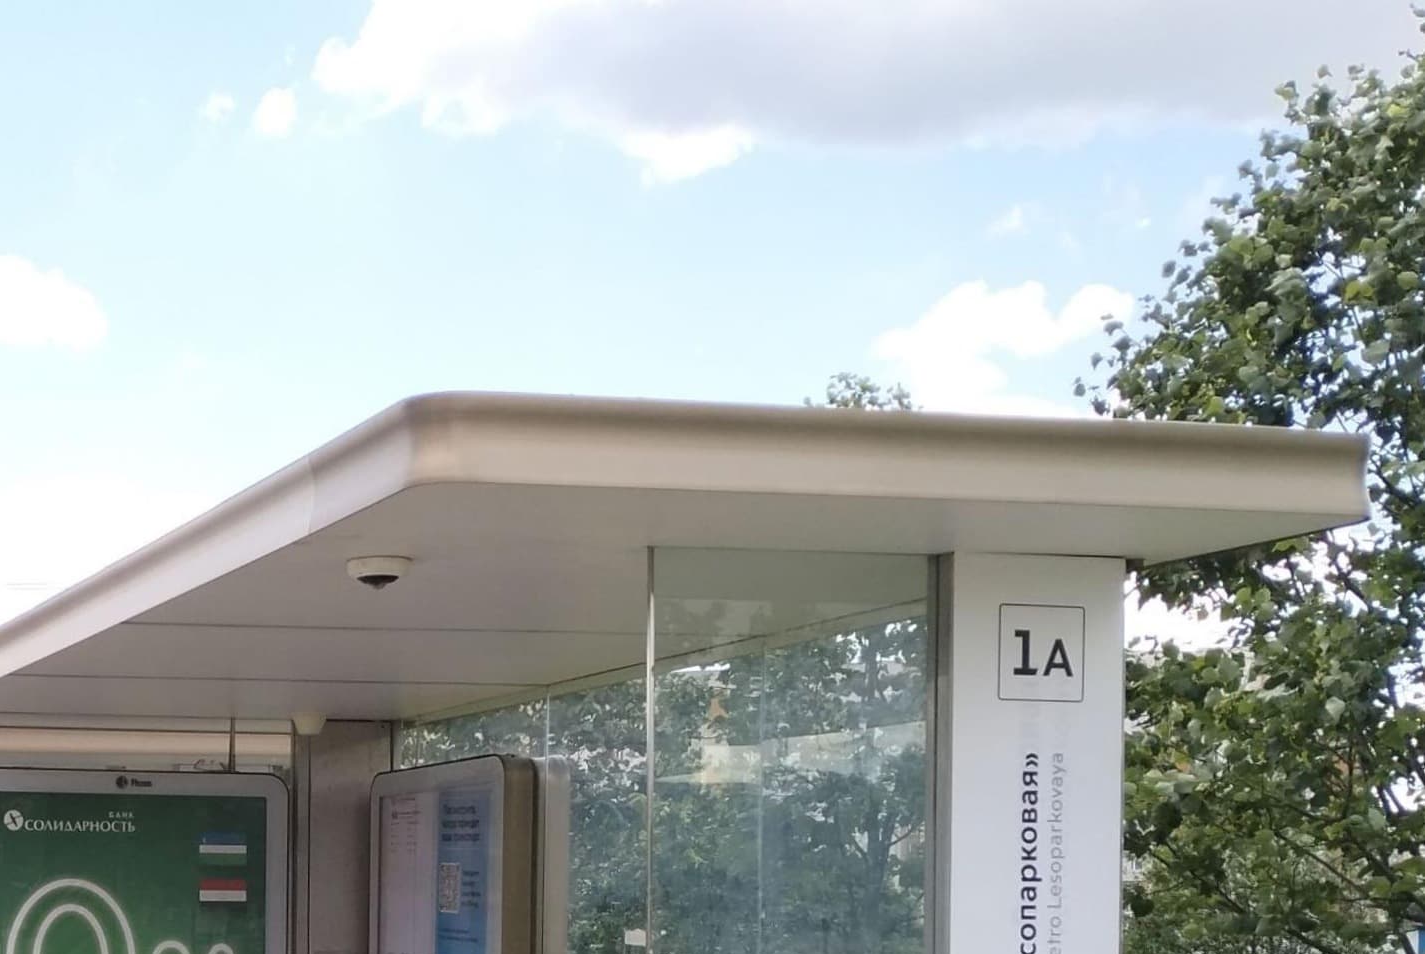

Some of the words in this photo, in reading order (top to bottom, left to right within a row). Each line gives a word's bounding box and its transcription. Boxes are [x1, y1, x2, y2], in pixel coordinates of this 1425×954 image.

[1012, 629, 1074, 677] 1А
[24, 819, 136, 833] СОЛИДАРНОСТЬ
[108, 811, 135, 819] БАНК
[1046, 752, 1068, 909] Lesoparkovaya
